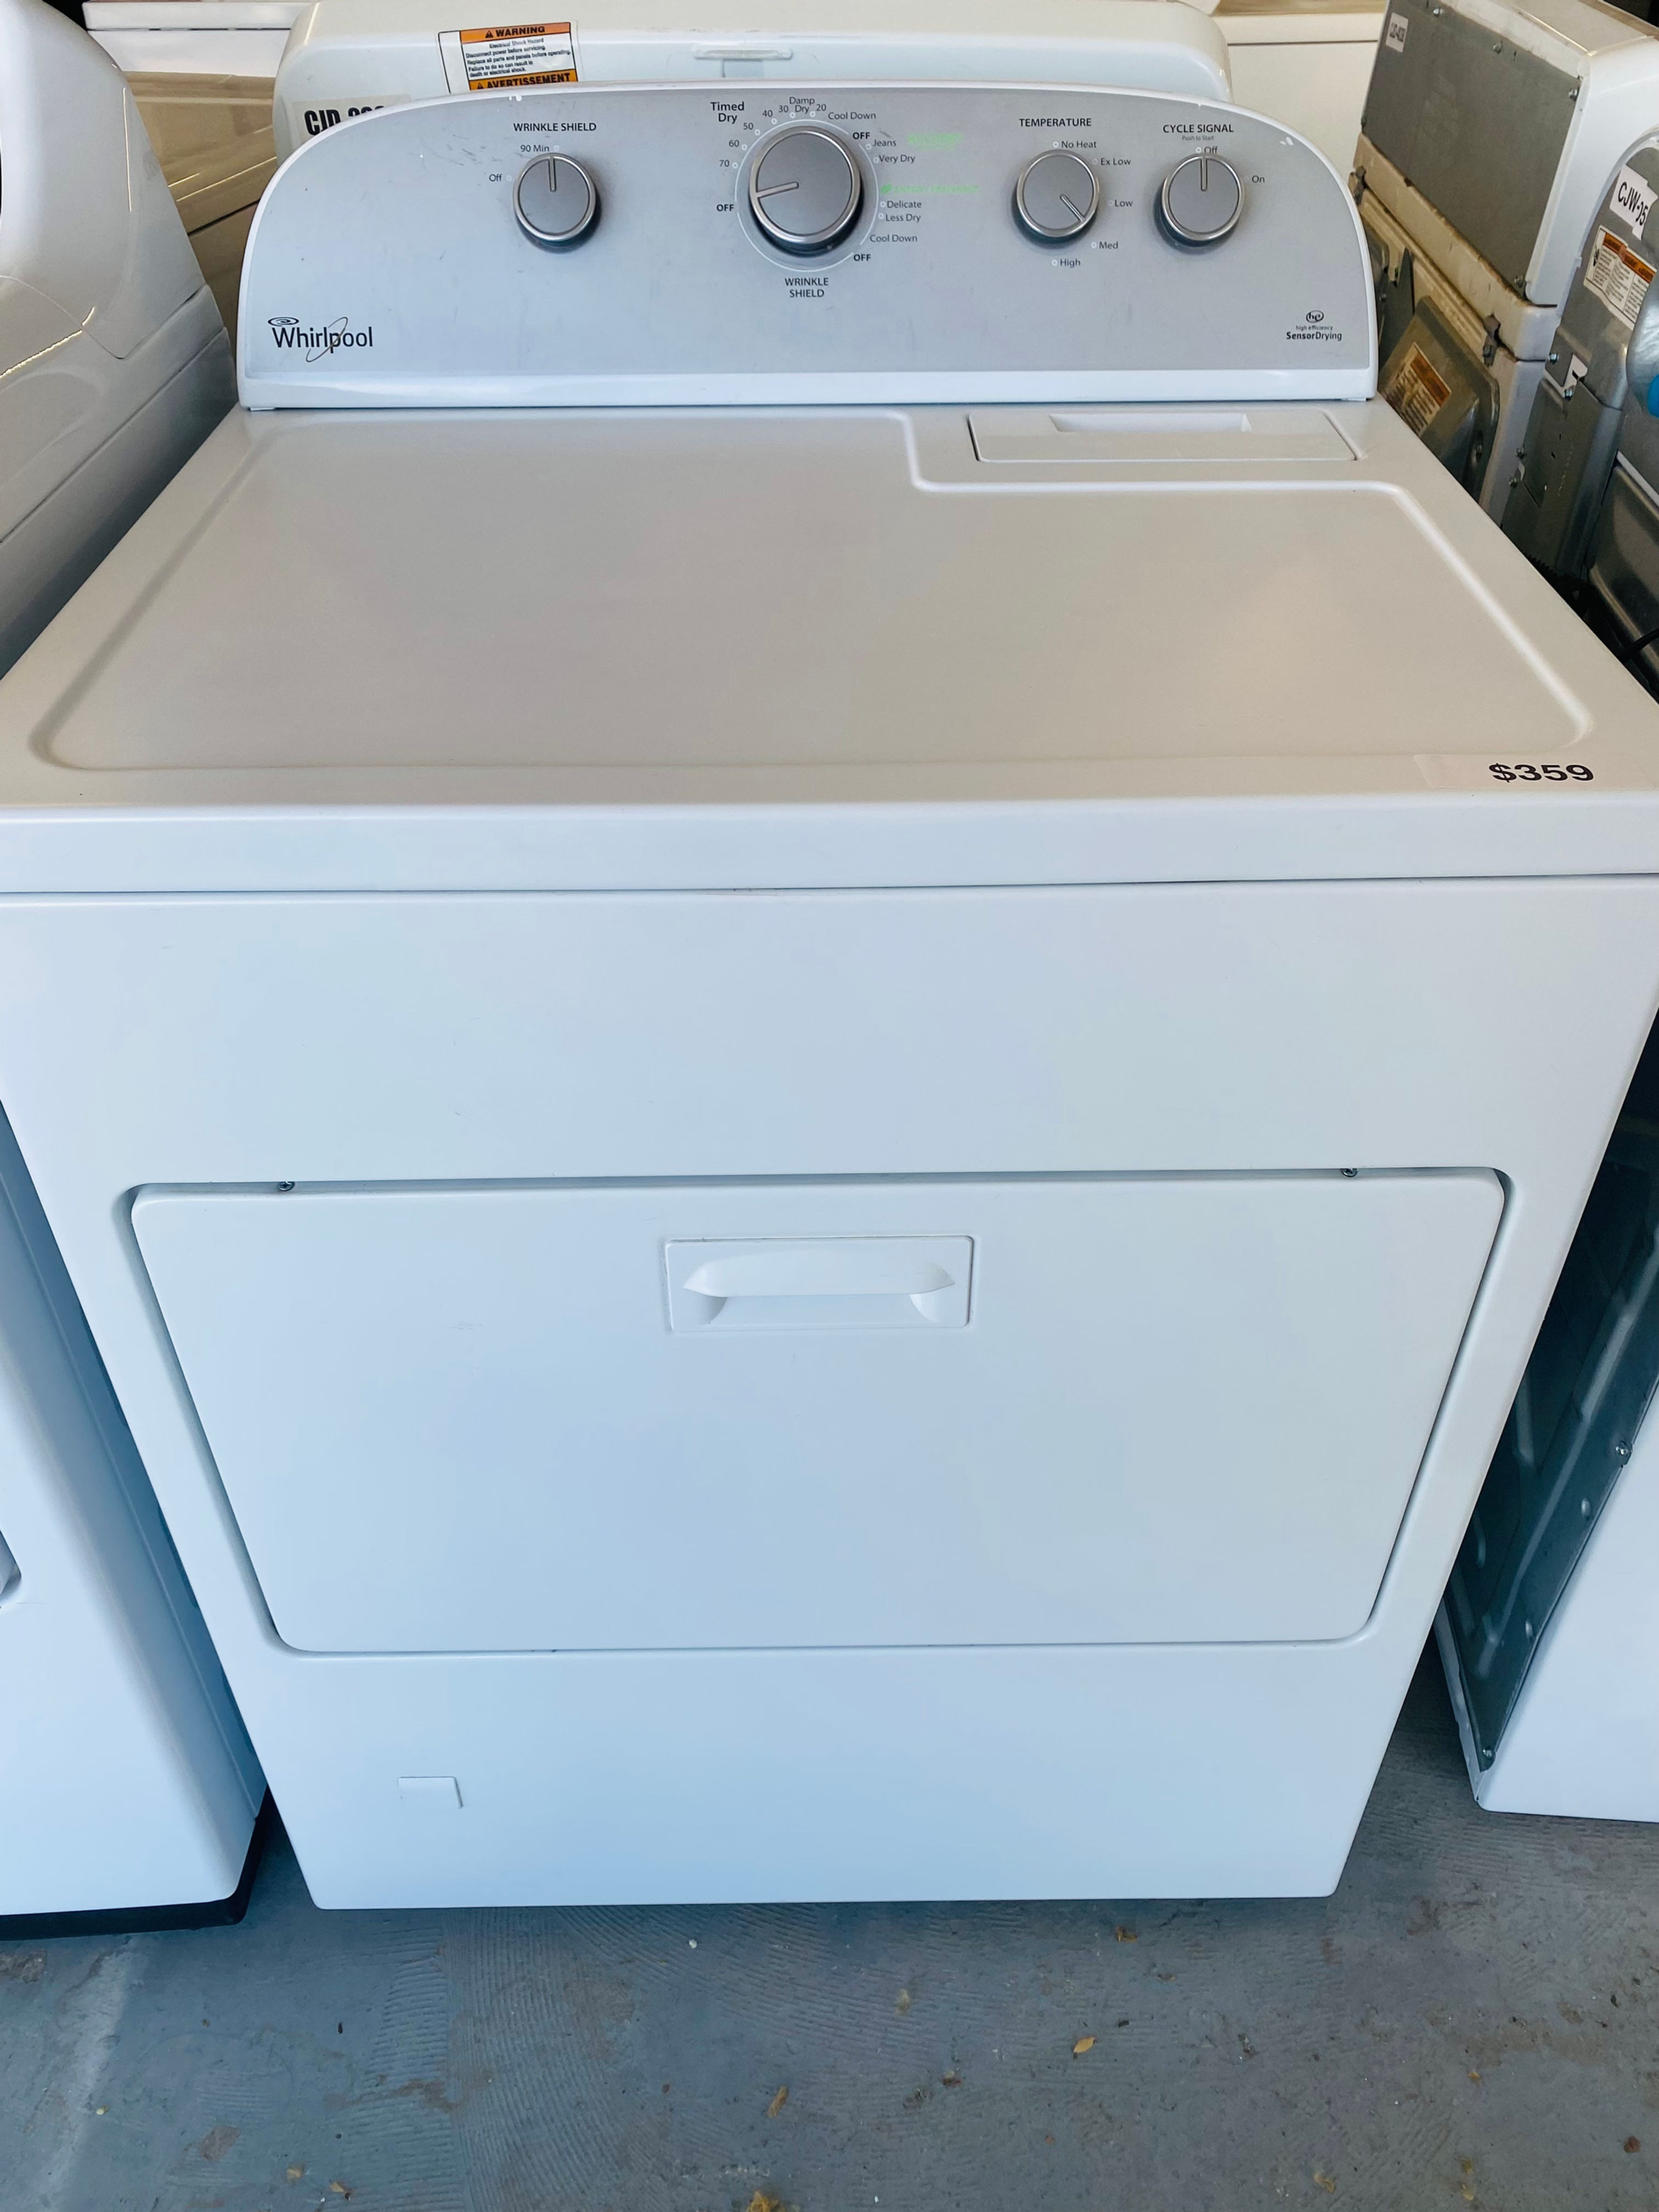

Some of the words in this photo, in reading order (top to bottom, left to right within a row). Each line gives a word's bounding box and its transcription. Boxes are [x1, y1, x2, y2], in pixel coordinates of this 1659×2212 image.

[495, 26, 545, 37] WARNING
[487, 73, 571, 89] AVERTISSEMENT
[710, 101, 745, 111] Timed
[789, 97, 815, 106] Damp
[795, 105, 810, 114] Dry
[718, 112, 738, 124] Dry
[1019, 118, 1092, 127] TEMPERATURE
[514, 123, 558, 131] WRINKLE
[561, 122, 596, 131] SHIELD
[1163, 124, 1195, 133] CYCLE
[1197, 124, 1234, 133] SIGNAL
[1204, 146, 1218, 154] Off
[878, 154, 898, 163] Very
[900, 154, 916, 163] Dry
[489, 173, 503, 182] Off
[1251, 175, 1265, 183] On
[887, 200, 922, 208] Delicate
[885, 213, 904, 222] Less
[906, 213, 921, 223] Dry
[870, 234, 890, 242] Cool
[853, 253, 871, 262] OFF
[1060, 258, 1081, 268] High
[785, 278, 829, 286] WRINKLE
[789, 289, 825, 297] SHIELD
[272, 326, 373, 354] Whirlpool
[1286, 331, 1342, 341] SensorDrying
[1488, 763, 1594, 783] $359
